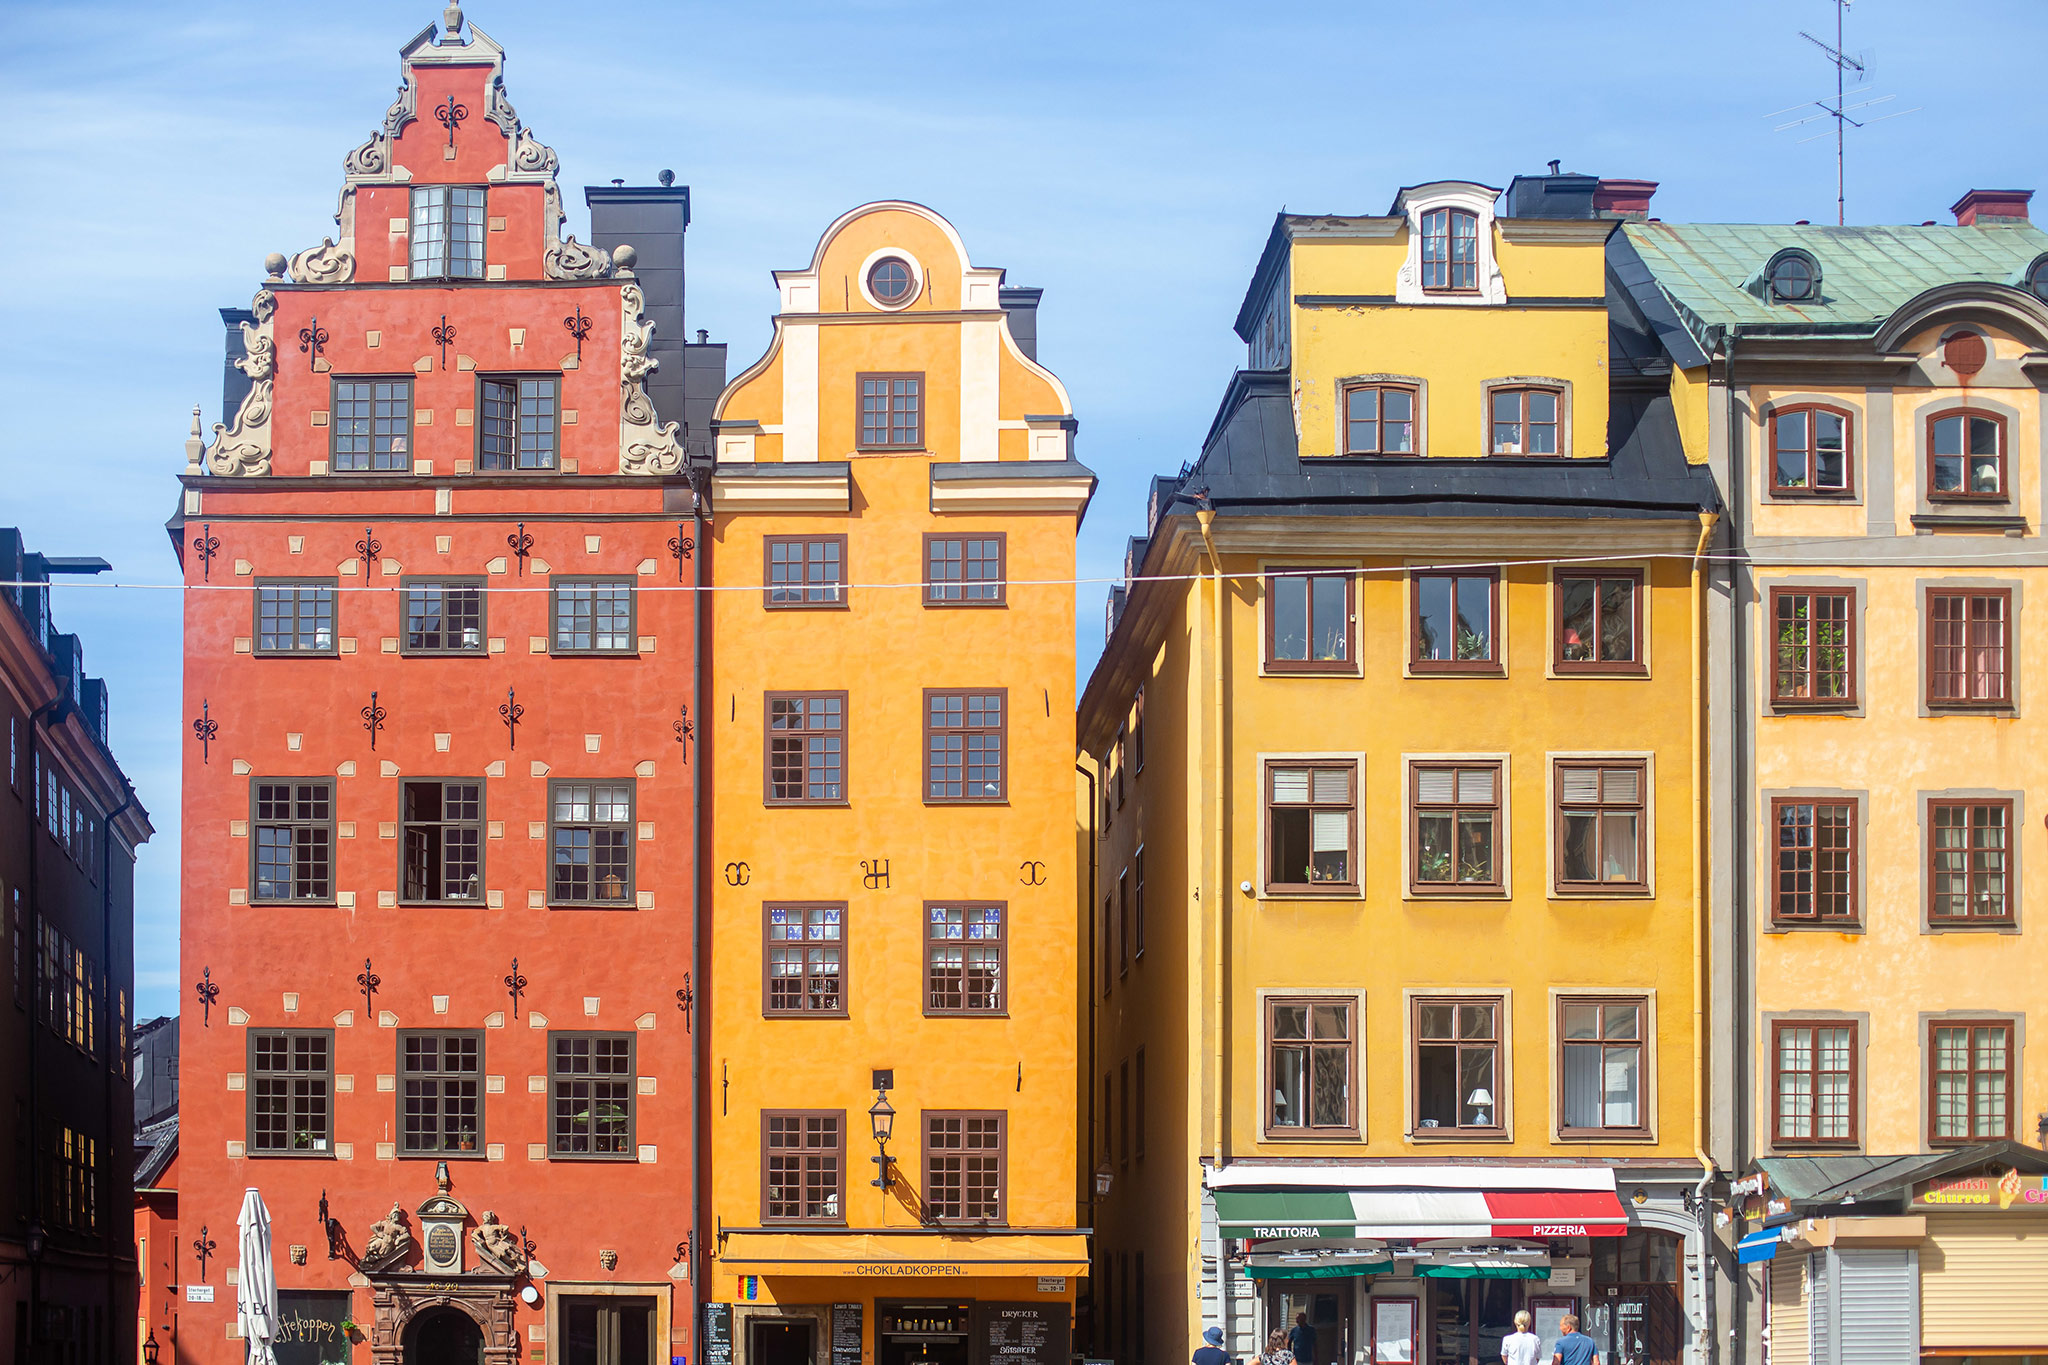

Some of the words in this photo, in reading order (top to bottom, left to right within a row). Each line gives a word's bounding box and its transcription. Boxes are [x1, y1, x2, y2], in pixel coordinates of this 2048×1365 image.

[1929, 1179, 1988, 1192] Spanish
[1924, 1191, 1990, 1204] Churros
[1253, 1227, 1320, 1238] TRATTORIA
[1533, 1225, 1587, 1236] PIZZERIA
